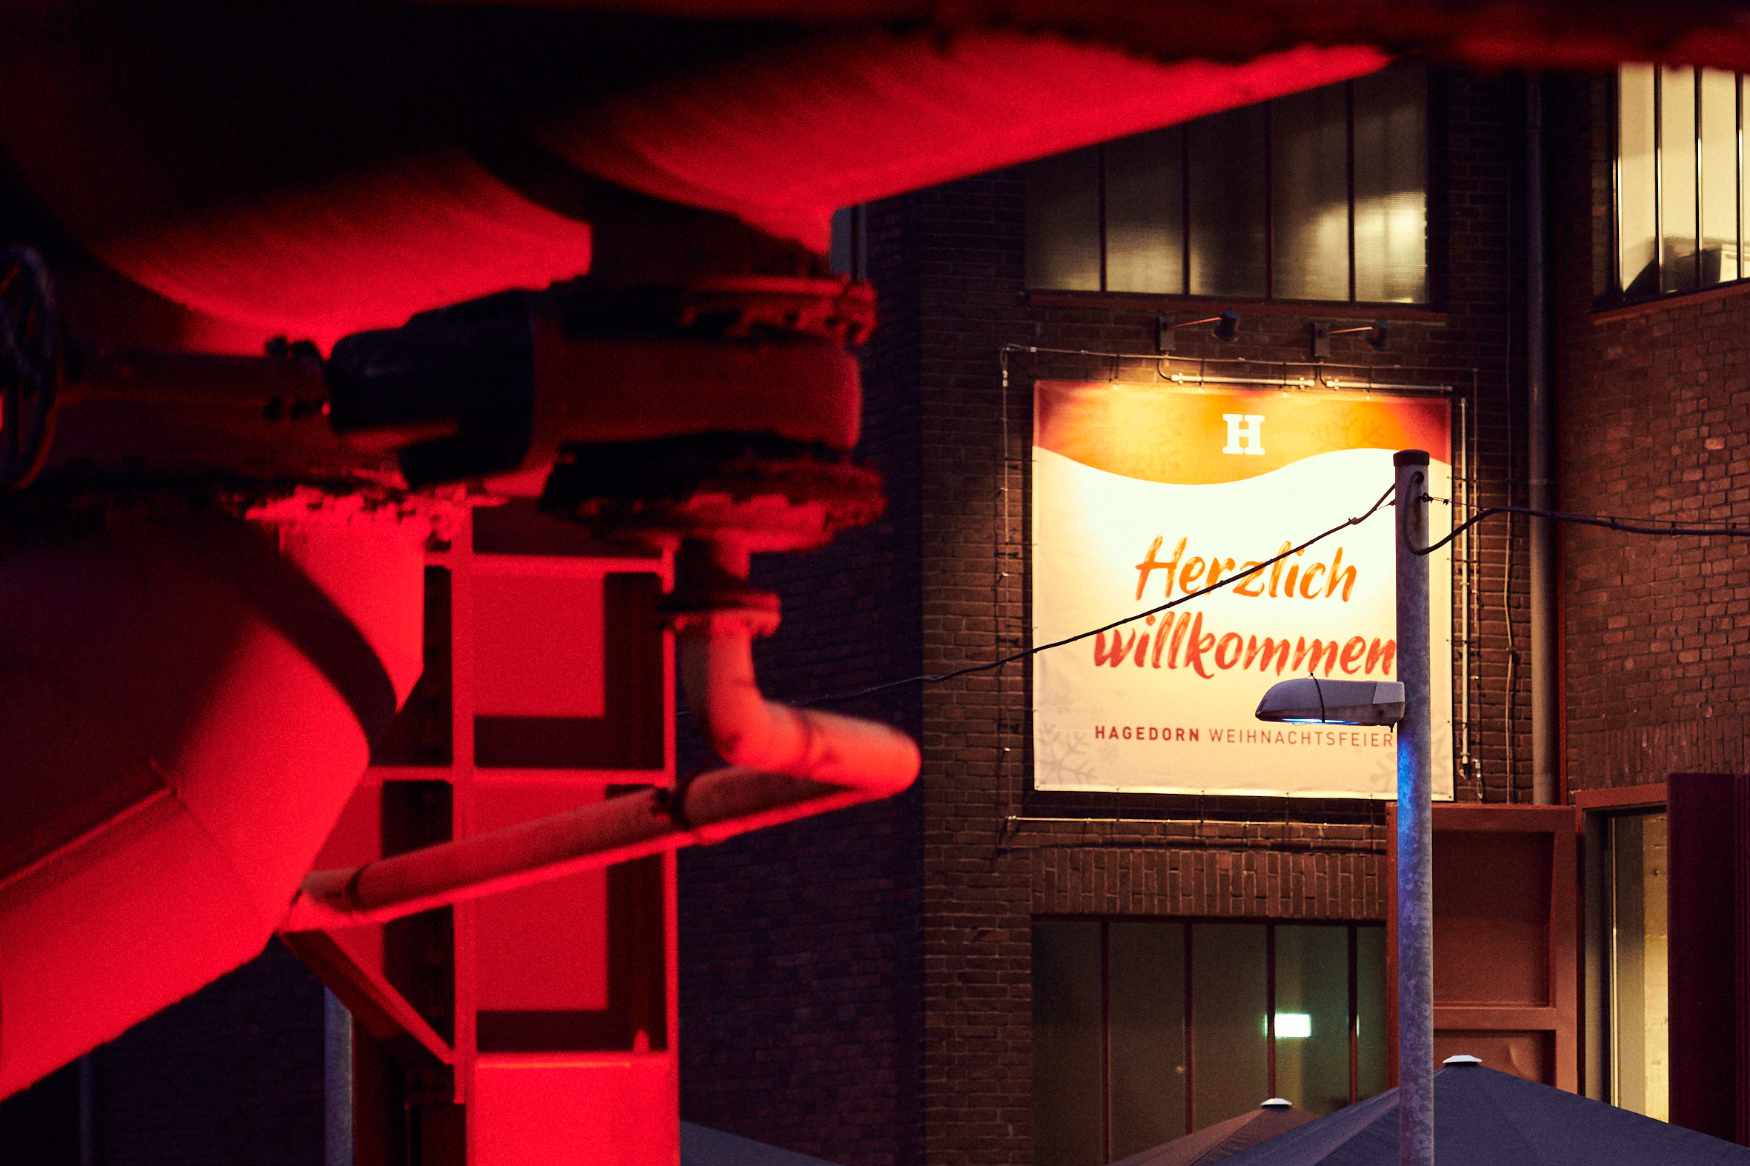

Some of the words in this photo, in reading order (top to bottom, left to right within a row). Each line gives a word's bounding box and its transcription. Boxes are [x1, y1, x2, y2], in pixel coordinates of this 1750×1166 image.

[1222, 413, 1266, 456] H
[1135, 535, 1358, 602] Herzlich
[1093, 611, 1397, 680] willkommen
[1095, 725, 1200, 742] HAGEDORN
[1209, 730, 1394, 748] WEIHNACHTSFEIER
